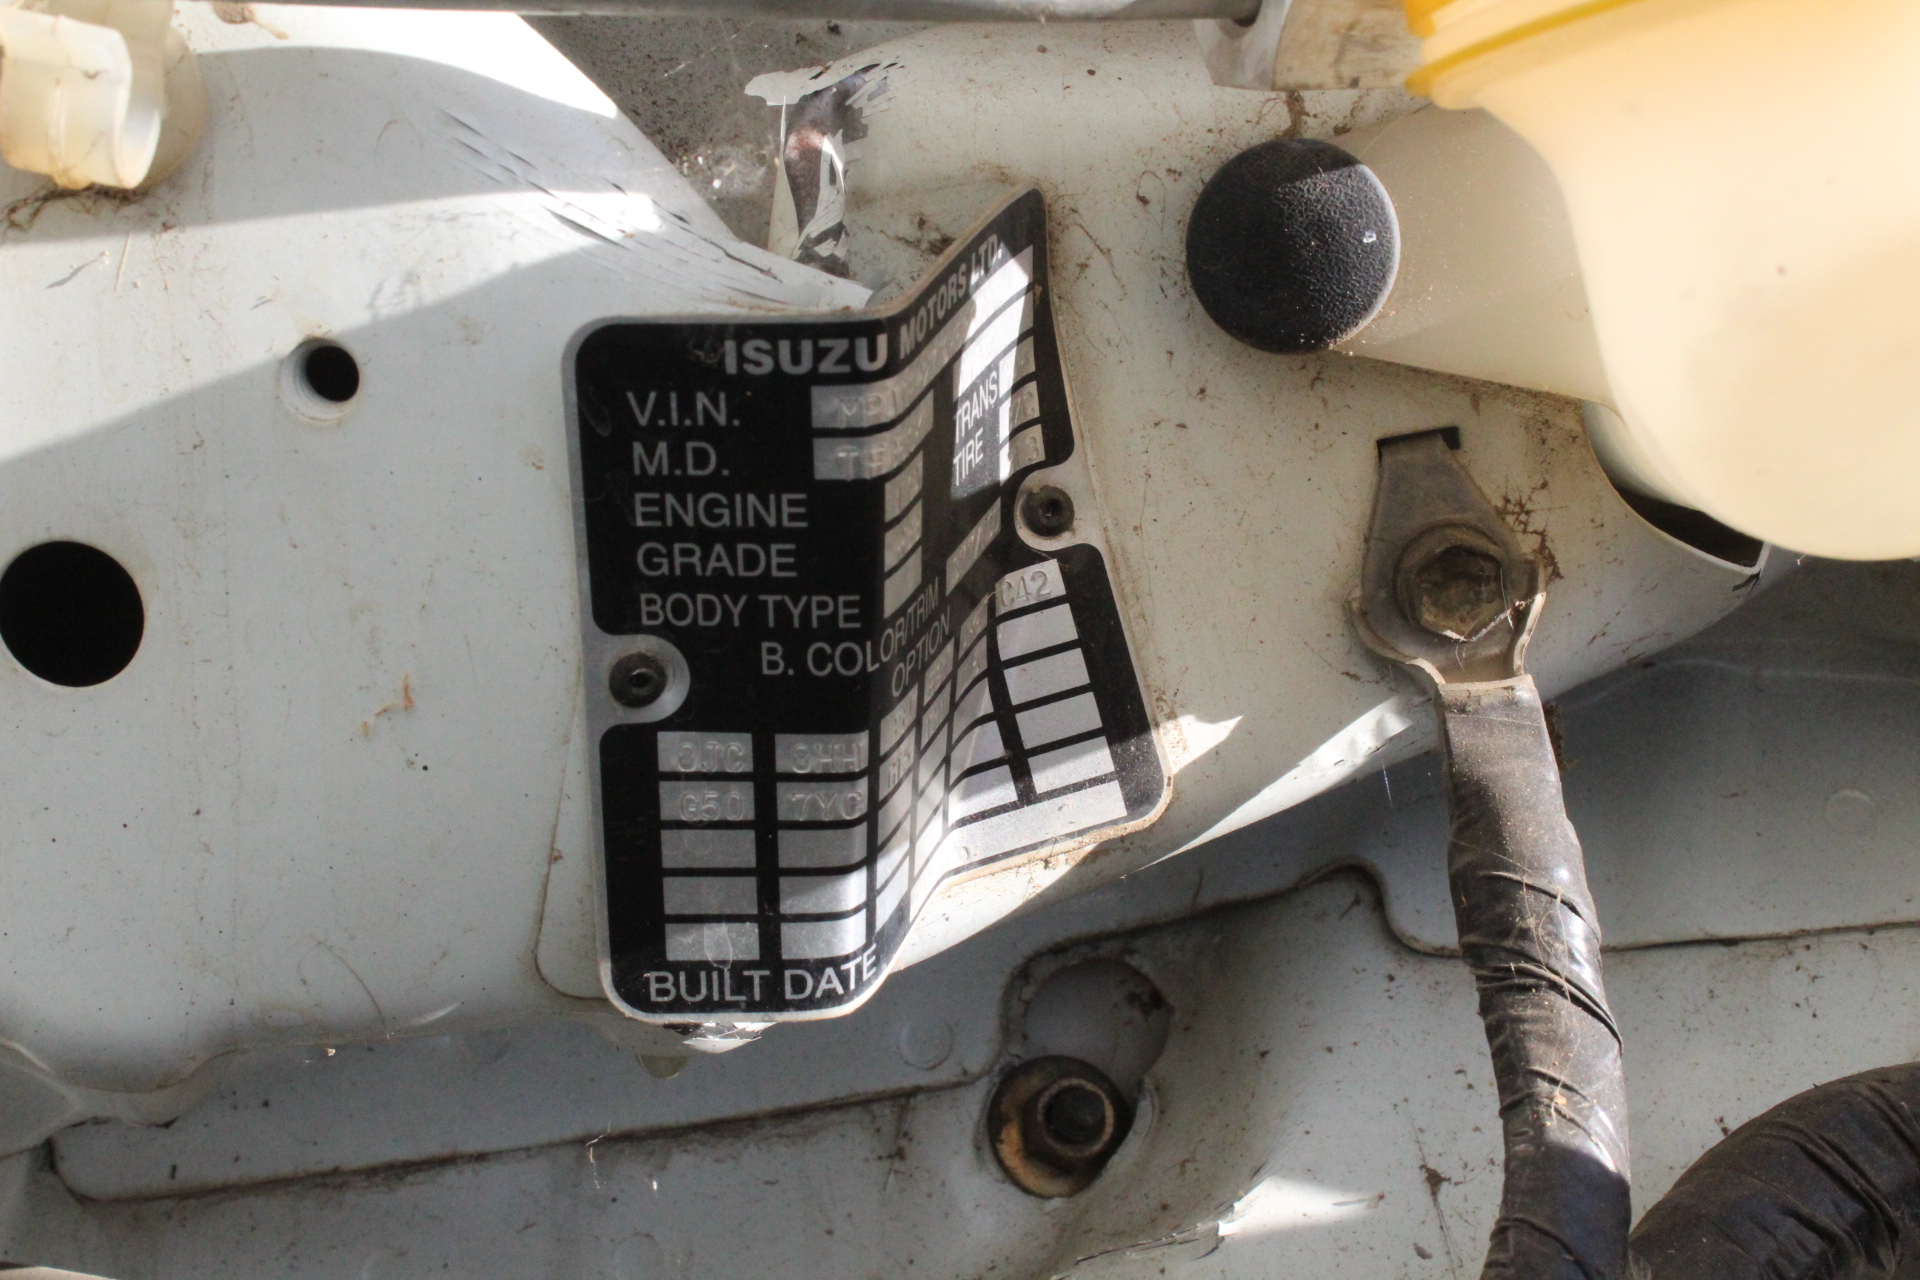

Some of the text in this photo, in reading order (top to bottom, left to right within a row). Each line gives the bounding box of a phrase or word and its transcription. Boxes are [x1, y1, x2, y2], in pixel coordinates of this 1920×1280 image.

[724, 333, 888, 375] ISUZU
[899, 264, 967, 360] MOTORS
[970, 234, 1003, 286] LTD.
[627, 391, 740, 426] V.I.N.
[954, 371, 998, 444] TRANS
[633, 441, 730, 476] M.D.
[953, 434, 984, 486] TIRE
[635, 493, 808, 528] ENGINE
[637, 543, 798, 578] GRADE
[641, 594, 861, 629] BODY TYPE
[762, 642, 794, 675] B.
[892, 606, 951, 698] OPTION
[648, 945, 877, 1002] BUILT DATE
